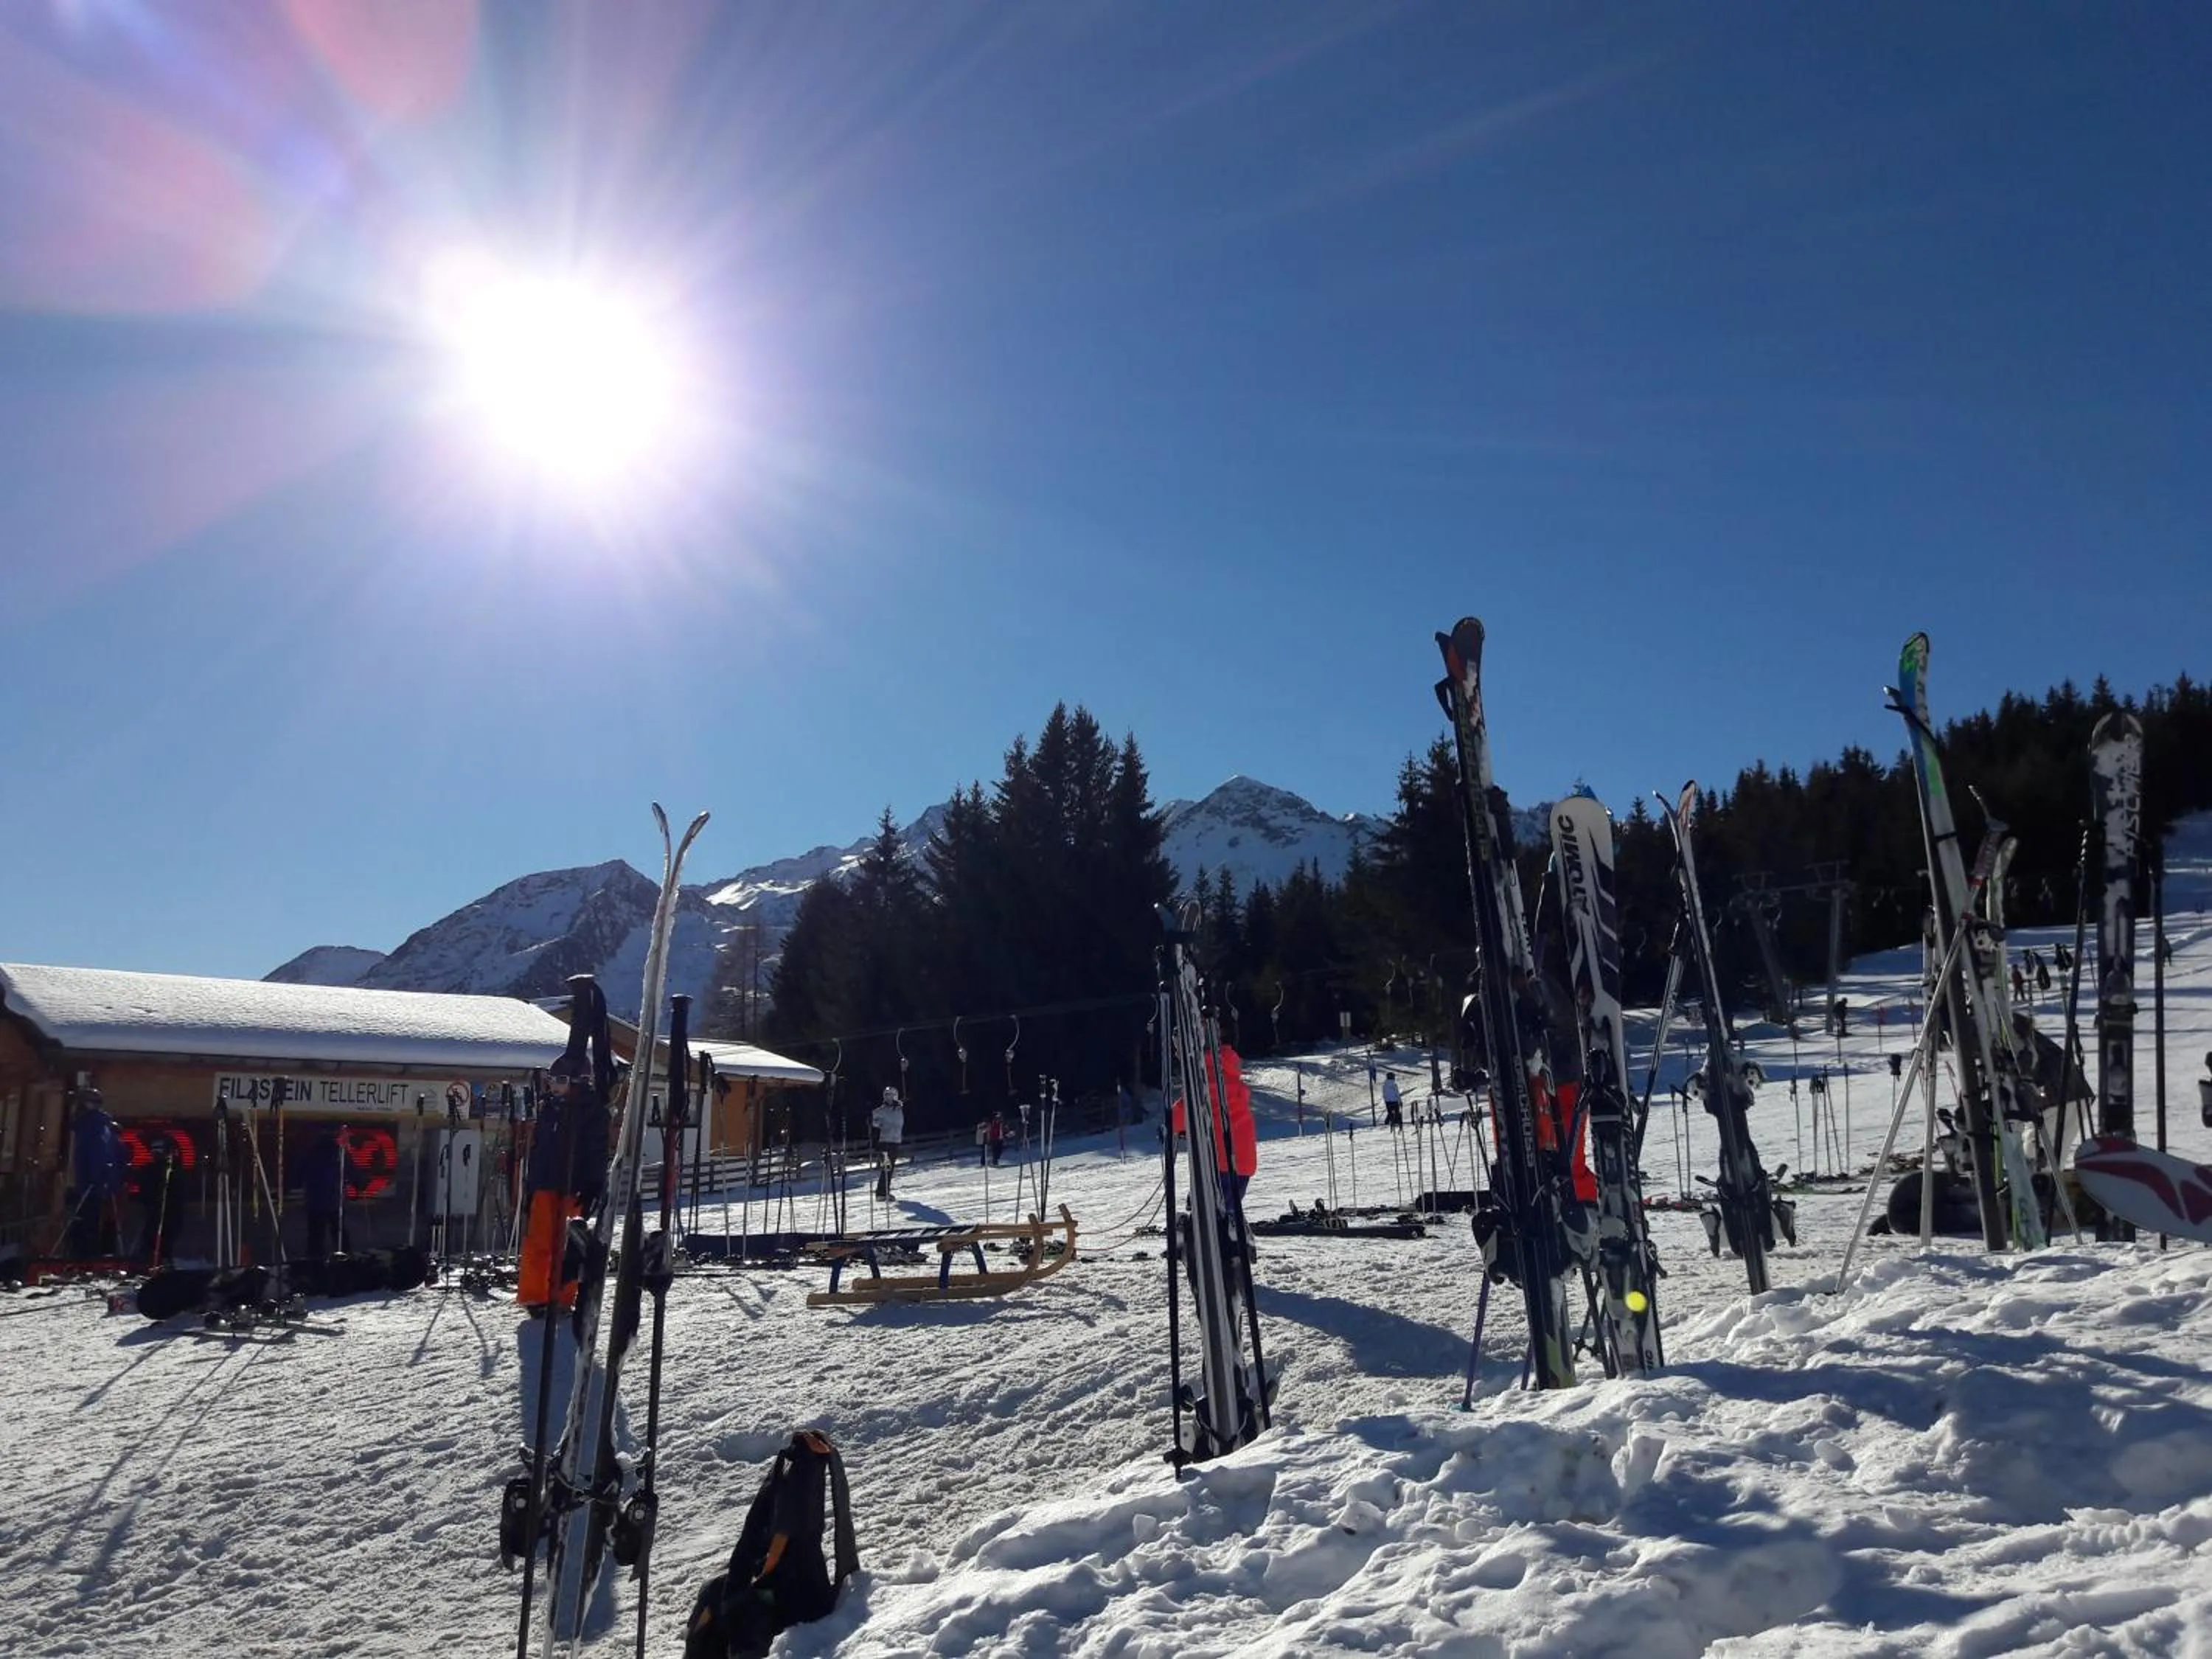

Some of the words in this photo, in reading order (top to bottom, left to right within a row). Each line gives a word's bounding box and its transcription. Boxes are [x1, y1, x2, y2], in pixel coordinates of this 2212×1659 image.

[1557, 813, 1590, 916] ATOMIC
[218, 1077, 313, 1102] FILZSEIN
[319, 1080, 409, 1105] TELLERLIFT
